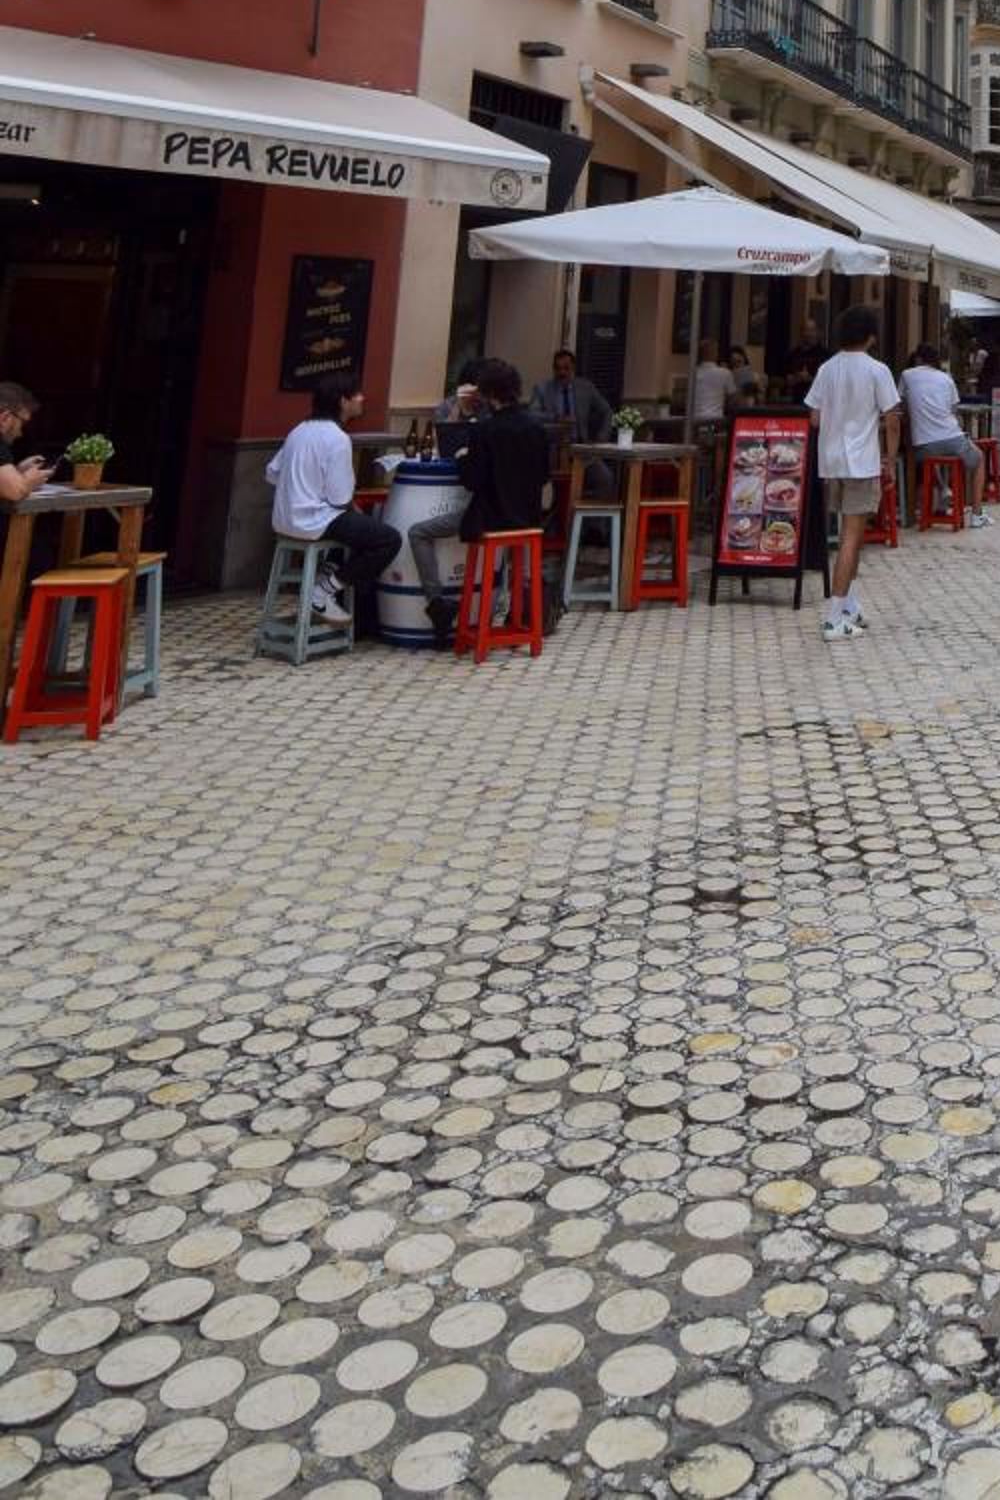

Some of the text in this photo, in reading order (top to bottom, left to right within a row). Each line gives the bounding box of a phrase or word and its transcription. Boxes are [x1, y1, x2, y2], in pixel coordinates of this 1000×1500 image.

[163, 132, 406, 190] PEPA REVUELO
[737, 246, 811, 266] Cruzcampo
